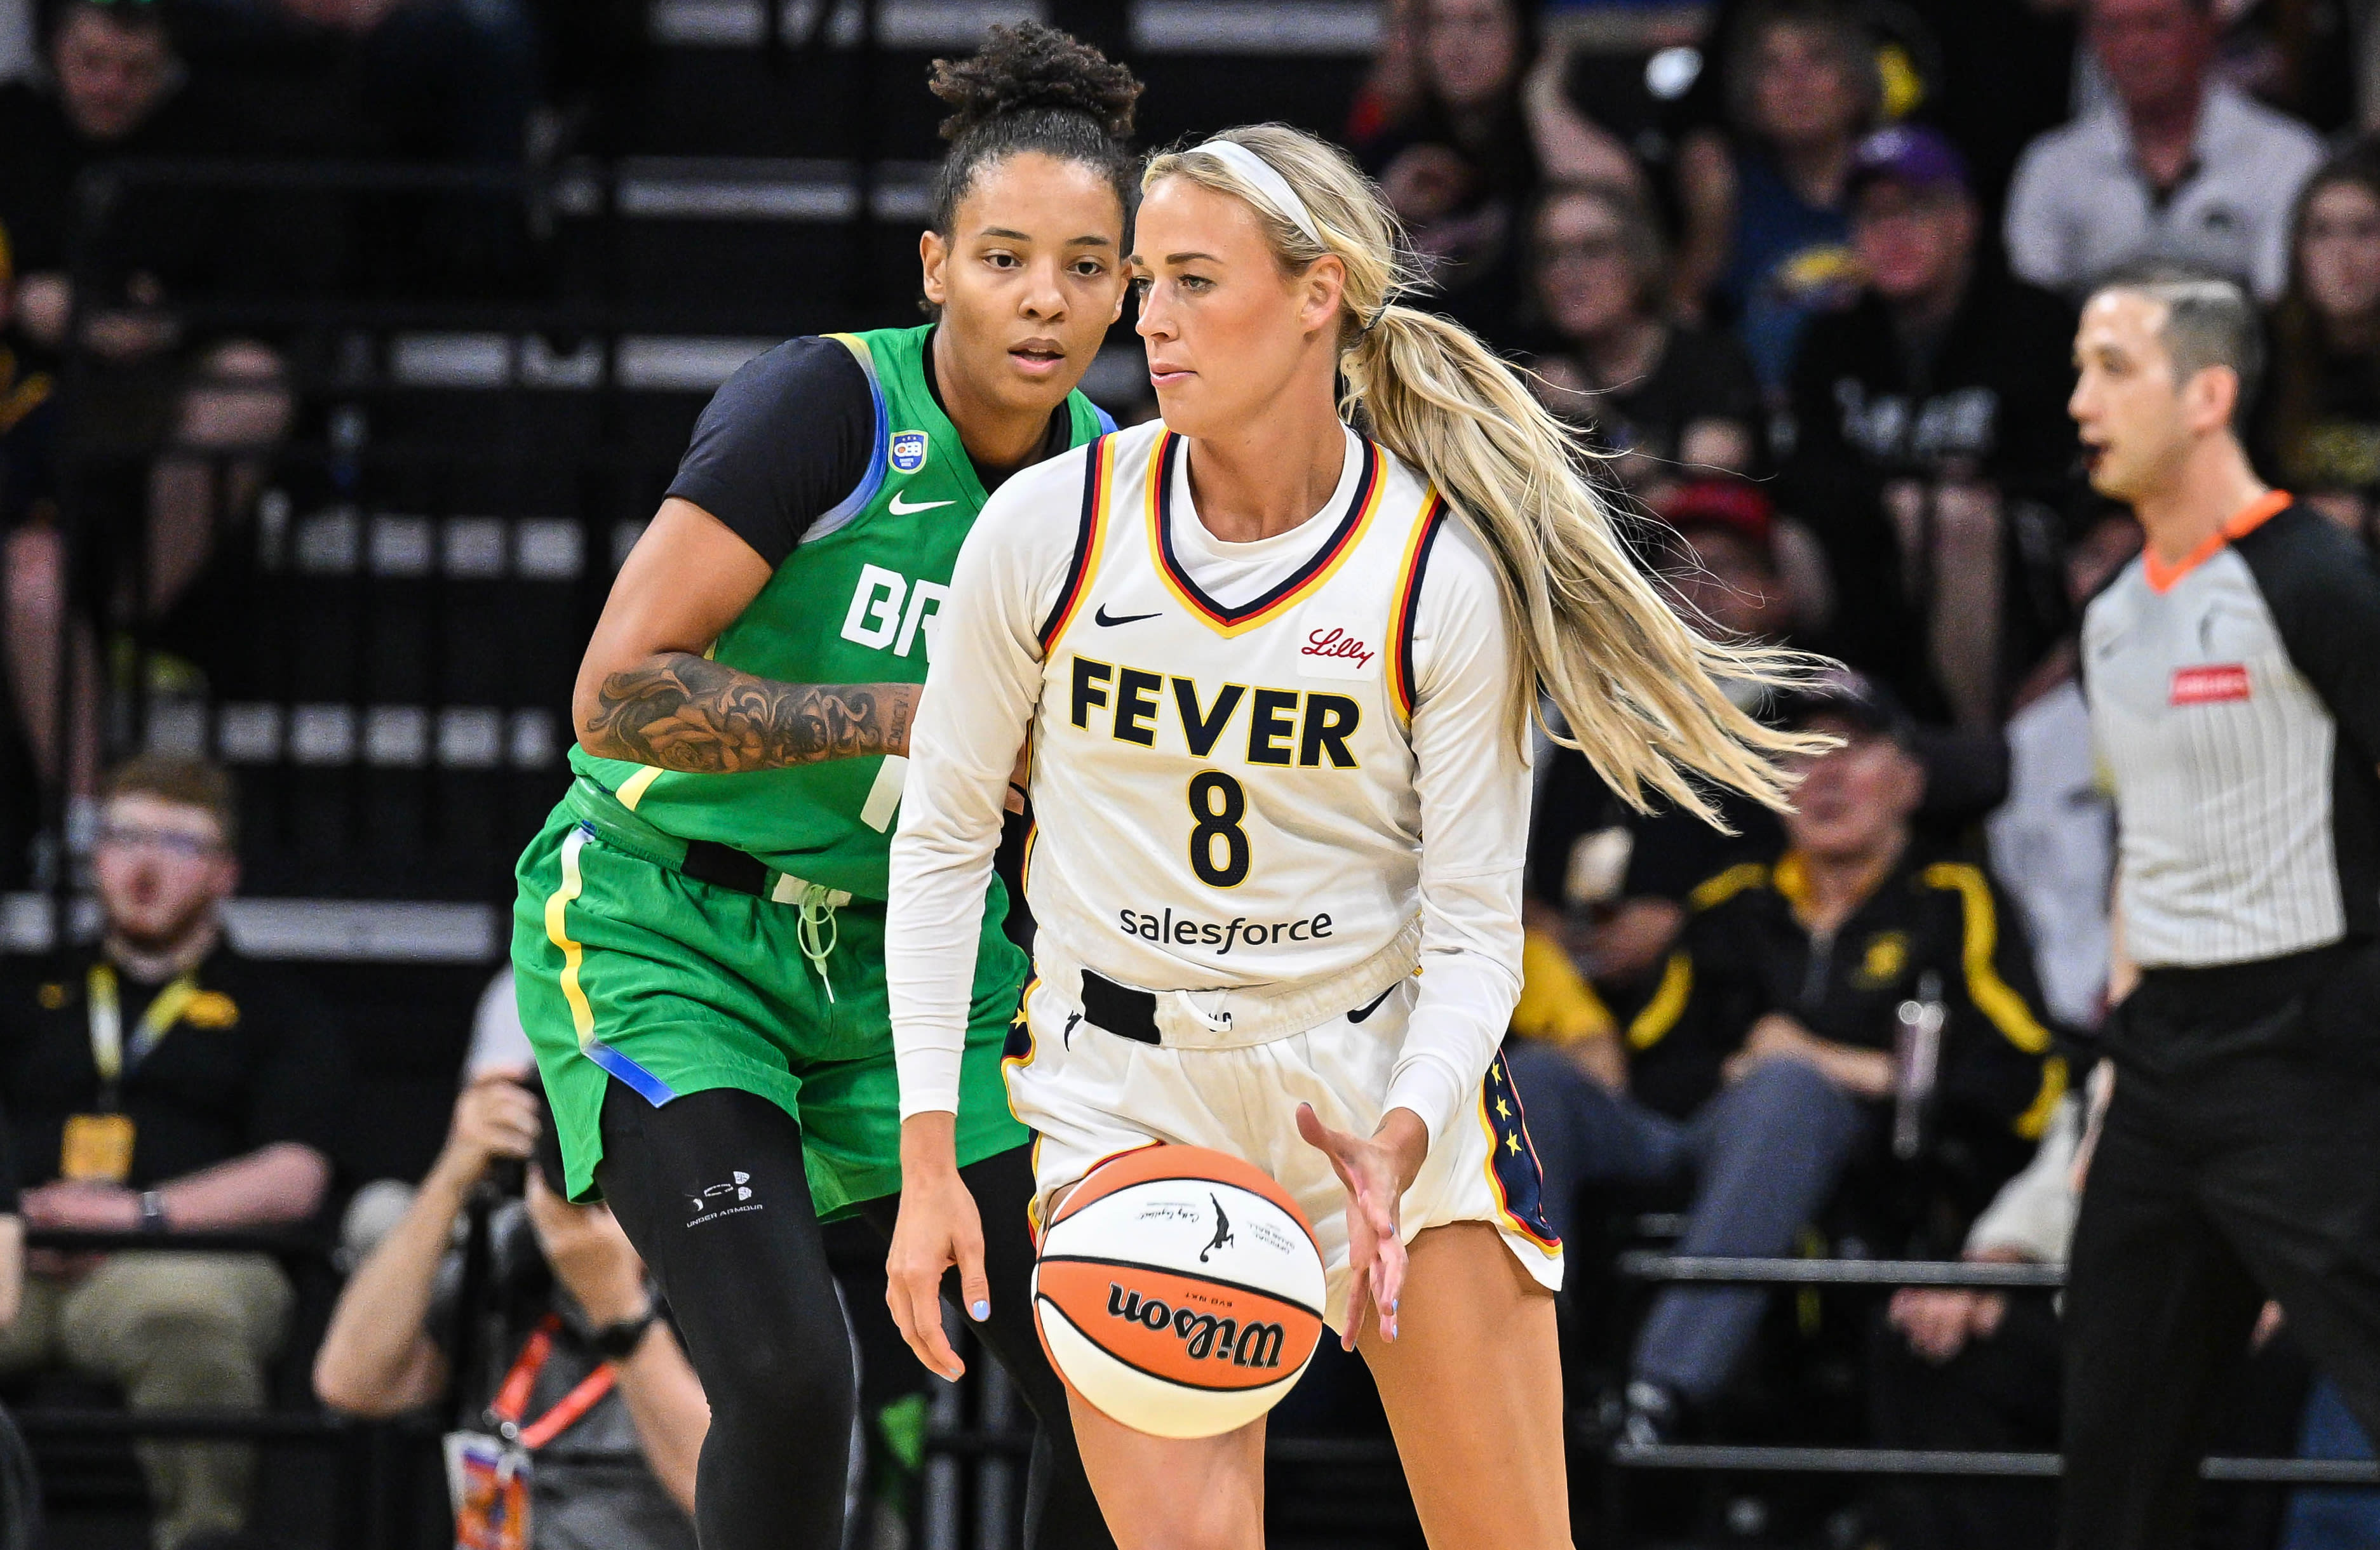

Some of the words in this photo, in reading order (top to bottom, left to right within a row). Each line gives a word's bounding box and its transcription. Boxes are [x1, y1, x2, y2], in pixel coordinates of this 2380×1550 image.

[1301, 627, 1375, 669] Lilly
[1070, 652, 1361, 770] FEVER
[1187, 768, 1252, 889] 8
[1120, 907, 1334, 955] salesforce
[687, 1212, 717, 1228] UNDER
[720, 1204, 763, 1217] ARMOUR
[1106, 1280, 1286, 1369] Wilson
